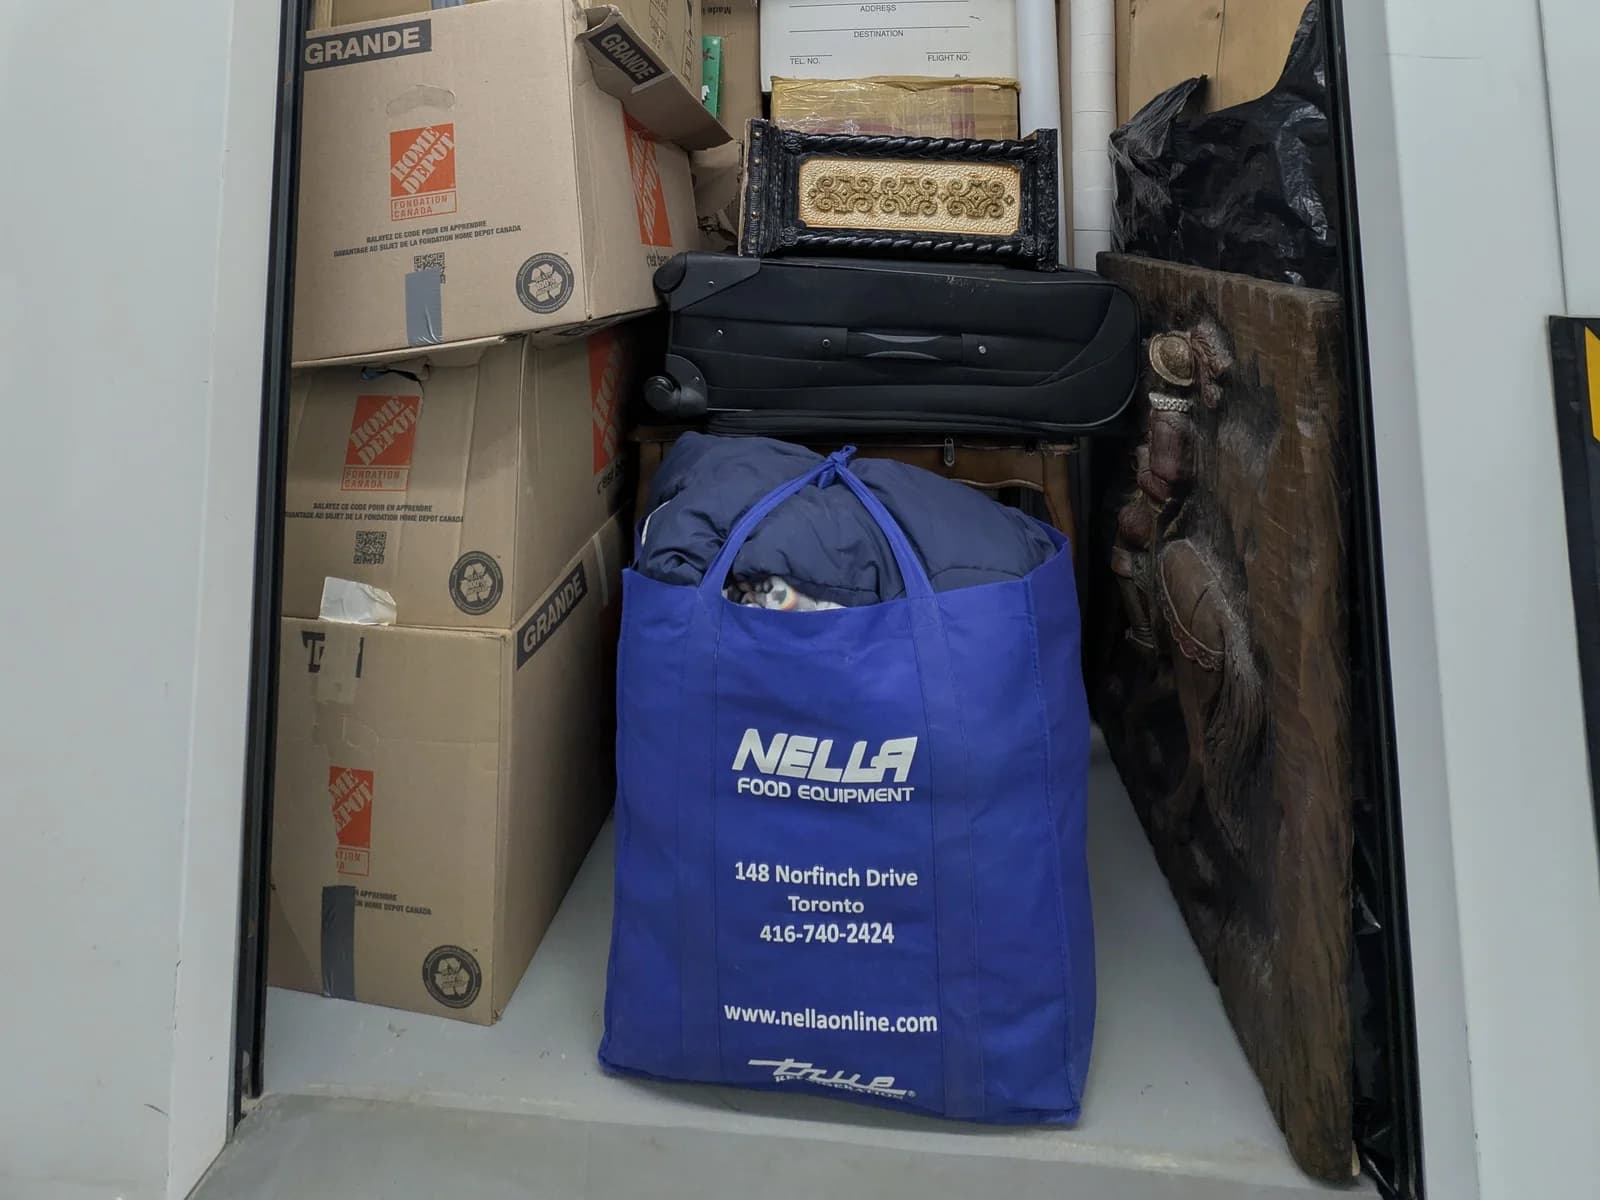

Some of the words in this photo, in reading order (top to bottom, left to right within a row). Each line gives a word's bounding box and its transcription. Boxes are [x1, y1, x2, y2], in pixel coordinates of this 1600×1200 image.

[860, 4, 897, 13] ADDRESS
[304, 26, 420, 65] GRANDE
[853, 29, 904, 39] DESTINATION
[600, 33, 655, 80] GRANDE
[807, 57, 821, 65] NO.
[927, 54, 955, 62] FLIGHT
[956, 53, 970, 62] NO.
[391, 126, 440, 182] HOME
[402, 132, 455, 194] DEPOT
[393, 195, 448, 209] FONDATION
[393, 206, 433, 218] CANADA
[366, 233, 393, 243] BALAYEZ
[394, 232, 403, 240] CE
[403, 230, 421, 238] CODE
[421, 227, 439, 236] POUR
[440, 225, 449, 233] EN
[450, 220, 487, 232] APPRENDRE
[379, 242, 399, 251] SUJET
[409, 239, 418, 247] LA
[419, 234, 454, 245] FONDATION
[454, 231, 473, 241] HOME
[474, 228, 494, 238] DEPOT
[495, 224, 522, 235] CANADA
[351, 396, 405, 449] HOME
[358, 404, 417, 465] DEPOT
[344, 470, 400, 480] FONDATION
[350, 503, 367, 511] CODE
[354, 513, 363, 521] LA
[418, 514, 438, 523] DEPOT
[523, 571, 583, 653] GRANDE
[731, 728, 918, 783] NELLA
[737, 777, 791, 798] FOOD
[797, 784, 915, 803] EQUIPMENT
[735, 861, 770, 882] 148
[775, 864, 861, 888] Norfinch
[865, 867, 918, 888] Drive
[788, 895, 865, 914] Toronto
[759, 922, 895, 944] 416-740-2424
[724, 1004, 938, 1033] www.nellaonline.com
